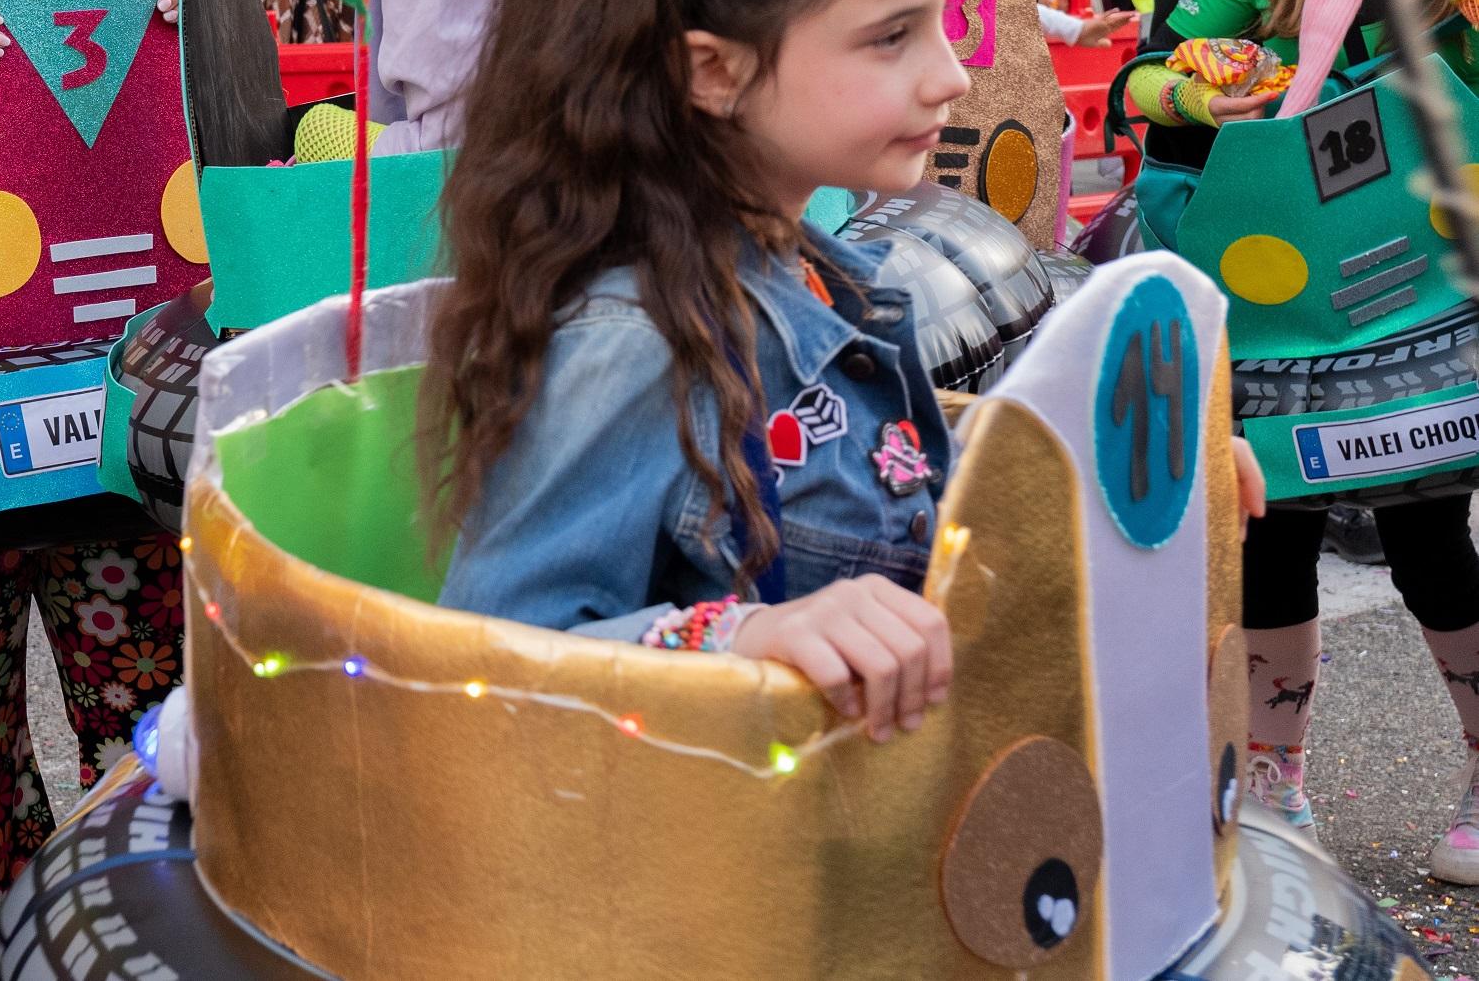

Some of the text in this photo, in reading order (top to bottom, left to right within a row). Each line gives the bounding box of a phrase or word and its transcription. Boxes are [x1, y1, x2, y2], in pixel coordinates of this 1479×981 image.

[52, 8, 110, 91] 3
[1318, 119, 1377, 178] 18
[1111, 318, 1186, 503] 14
[1336, 413, 1479, 461] VALEI CHOQ
[9, 442, 23, 460] E
[1309, 455, 1322, 469] E
